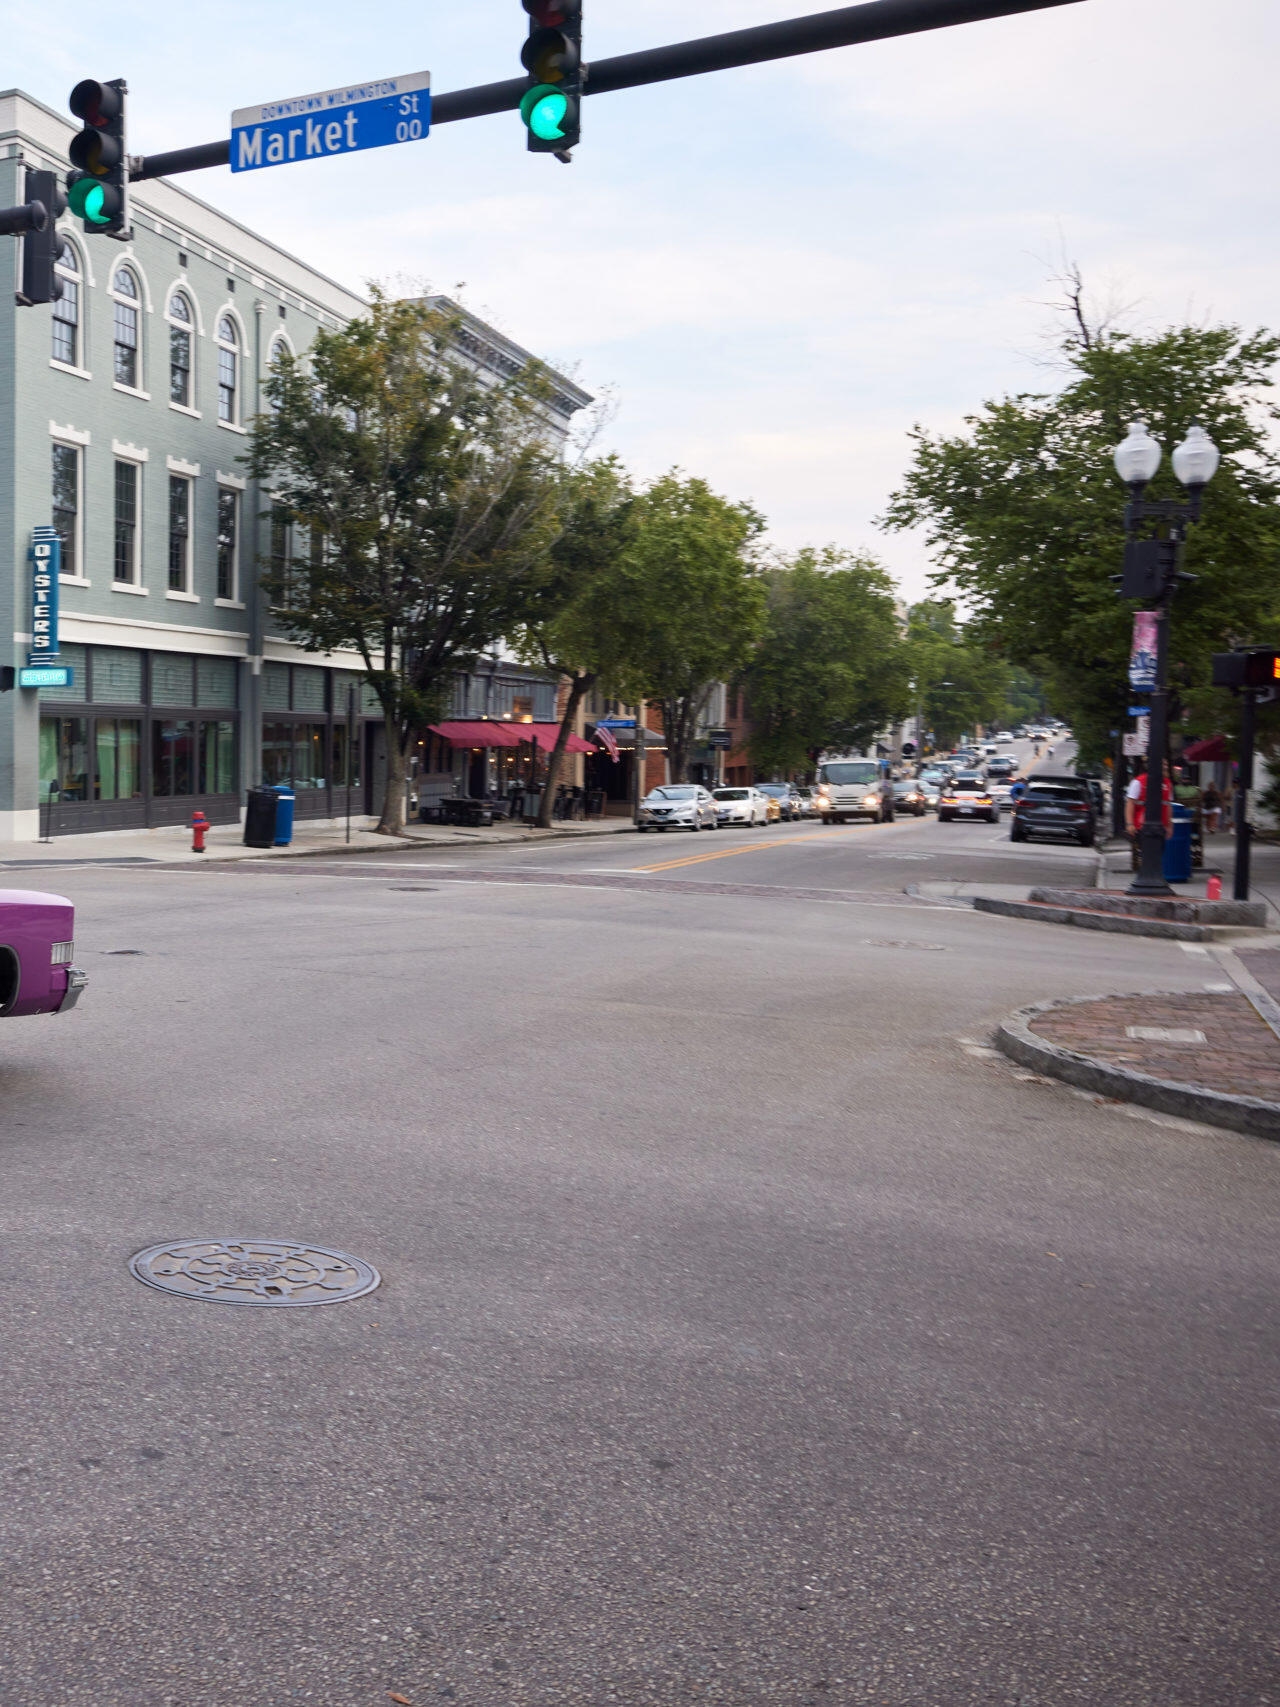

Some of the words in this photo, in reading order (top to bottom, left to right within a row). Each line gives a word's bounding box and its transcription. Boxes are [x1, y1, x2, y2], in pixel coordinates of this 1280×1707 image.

[261, 97, 322, 120] DOWNTOWN
[327, 81, 397, 105] WILMINGTON
[238, 110, 358, 169] Market
[397, 94, 420, 116] St
[395, 119, 422, 142] 00
[34, 544, 52, 648] OYSTERS
